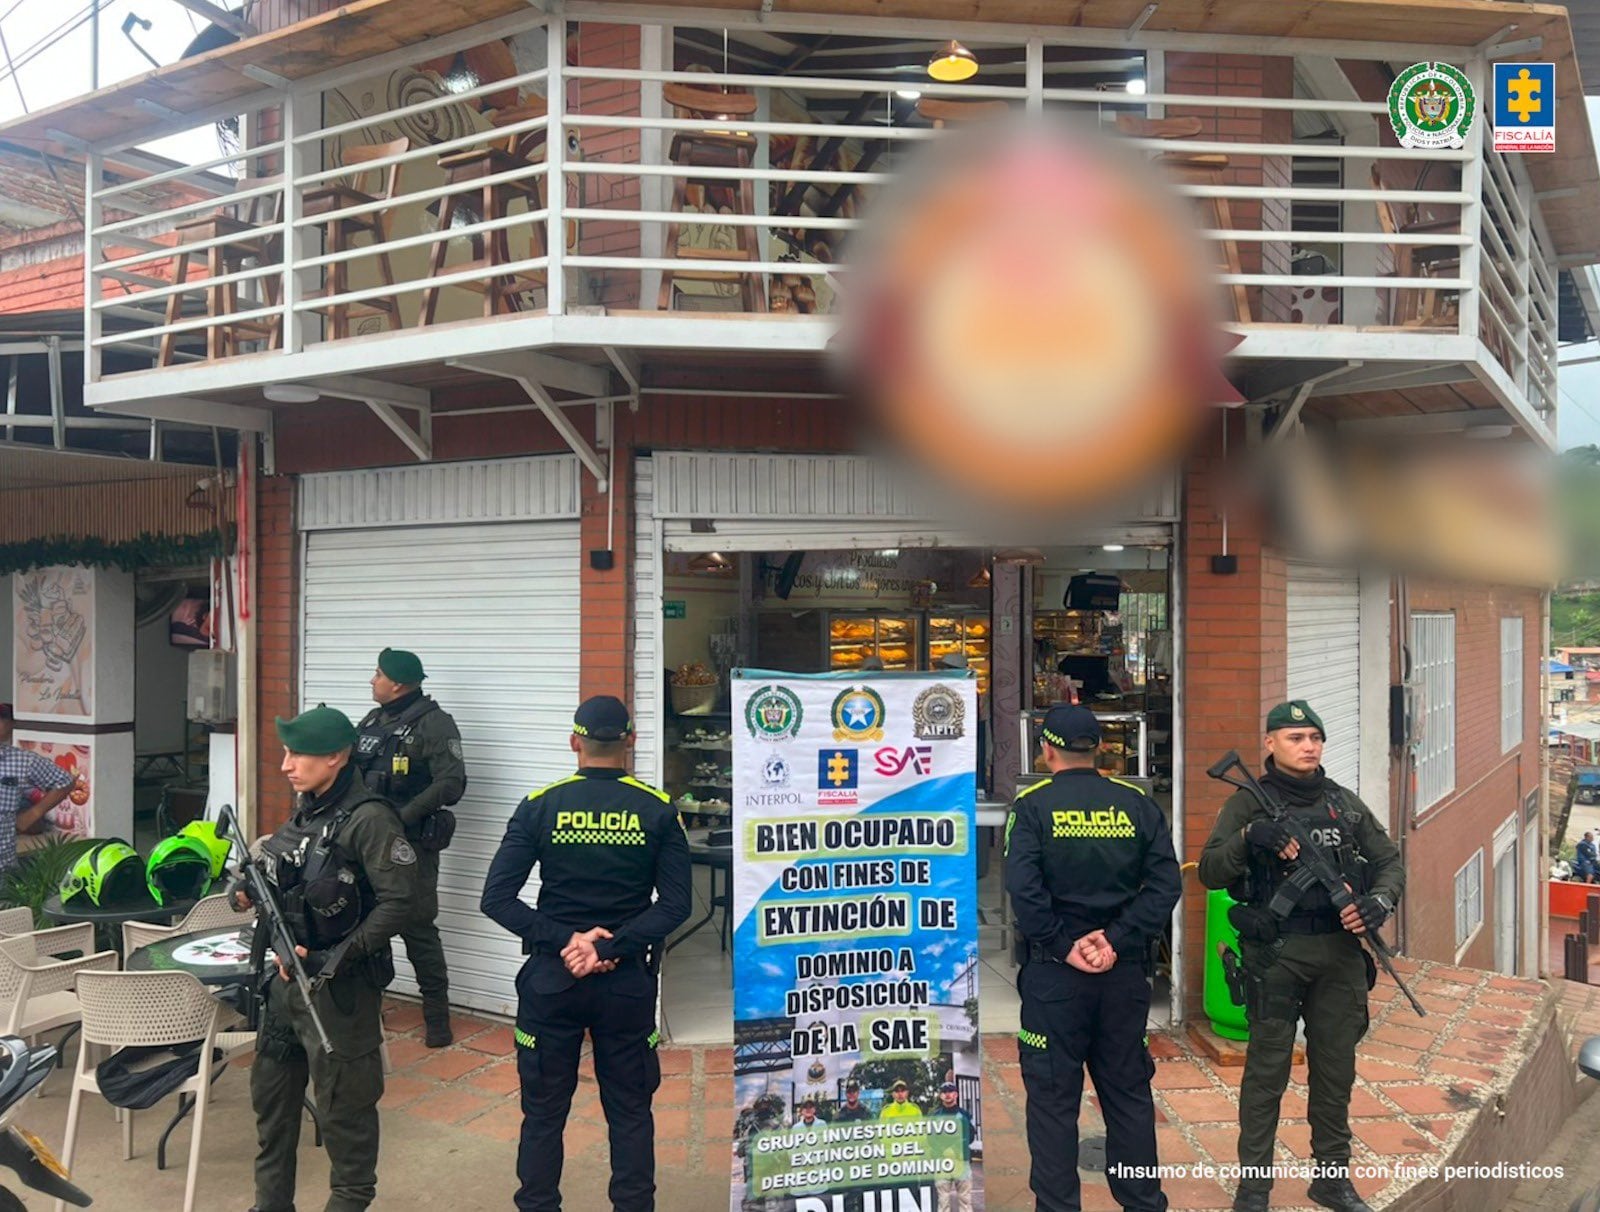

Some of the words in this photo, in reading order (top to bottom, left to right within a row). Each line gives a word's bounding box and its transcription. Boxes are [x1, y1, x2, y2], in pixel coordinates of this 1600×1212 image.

[922, 725, 955, 736] AIFIT
[745, 792, 801, 806] INTERPOL
[556, 810, 641, 831] POLICÍA
[1052, 805, 1132, 826] POLICÍA
[757, 821, 817, 853] BIEN
[824, 818, 955, 849] OCUPADO
[782, 866, 828, 891] CON
[834, 862, 894, 888] FINES
[900, 861, 929, 884] DE
[764, 895, 906, 937] EXTINCIÓN
[921, 899, 956, 928] DE
[799, 950, 892, 979] DOMINIO
[899, 950, 914, 971] A
[787, 978, 928, 1015] DISPOSICIÓN
[793, 1028, 824, 1056] DE
[829, 1024, 858, 1051] LA
[872, 1019, 928, 1051] SAE
[757, 1132, 817, 1152] GRUPO
[823, 1119, 957, 1145] INVESTIGATIVO
[791, 1142, 886, 1167] EXTINCIÓN
[891, 1141, 924, 1156] DEL
[761, 1168, 843, 1191] DERECHO
[850, 1164, 872, 1180] DE
[877, 1158, 955, 1176] DOMINIO
